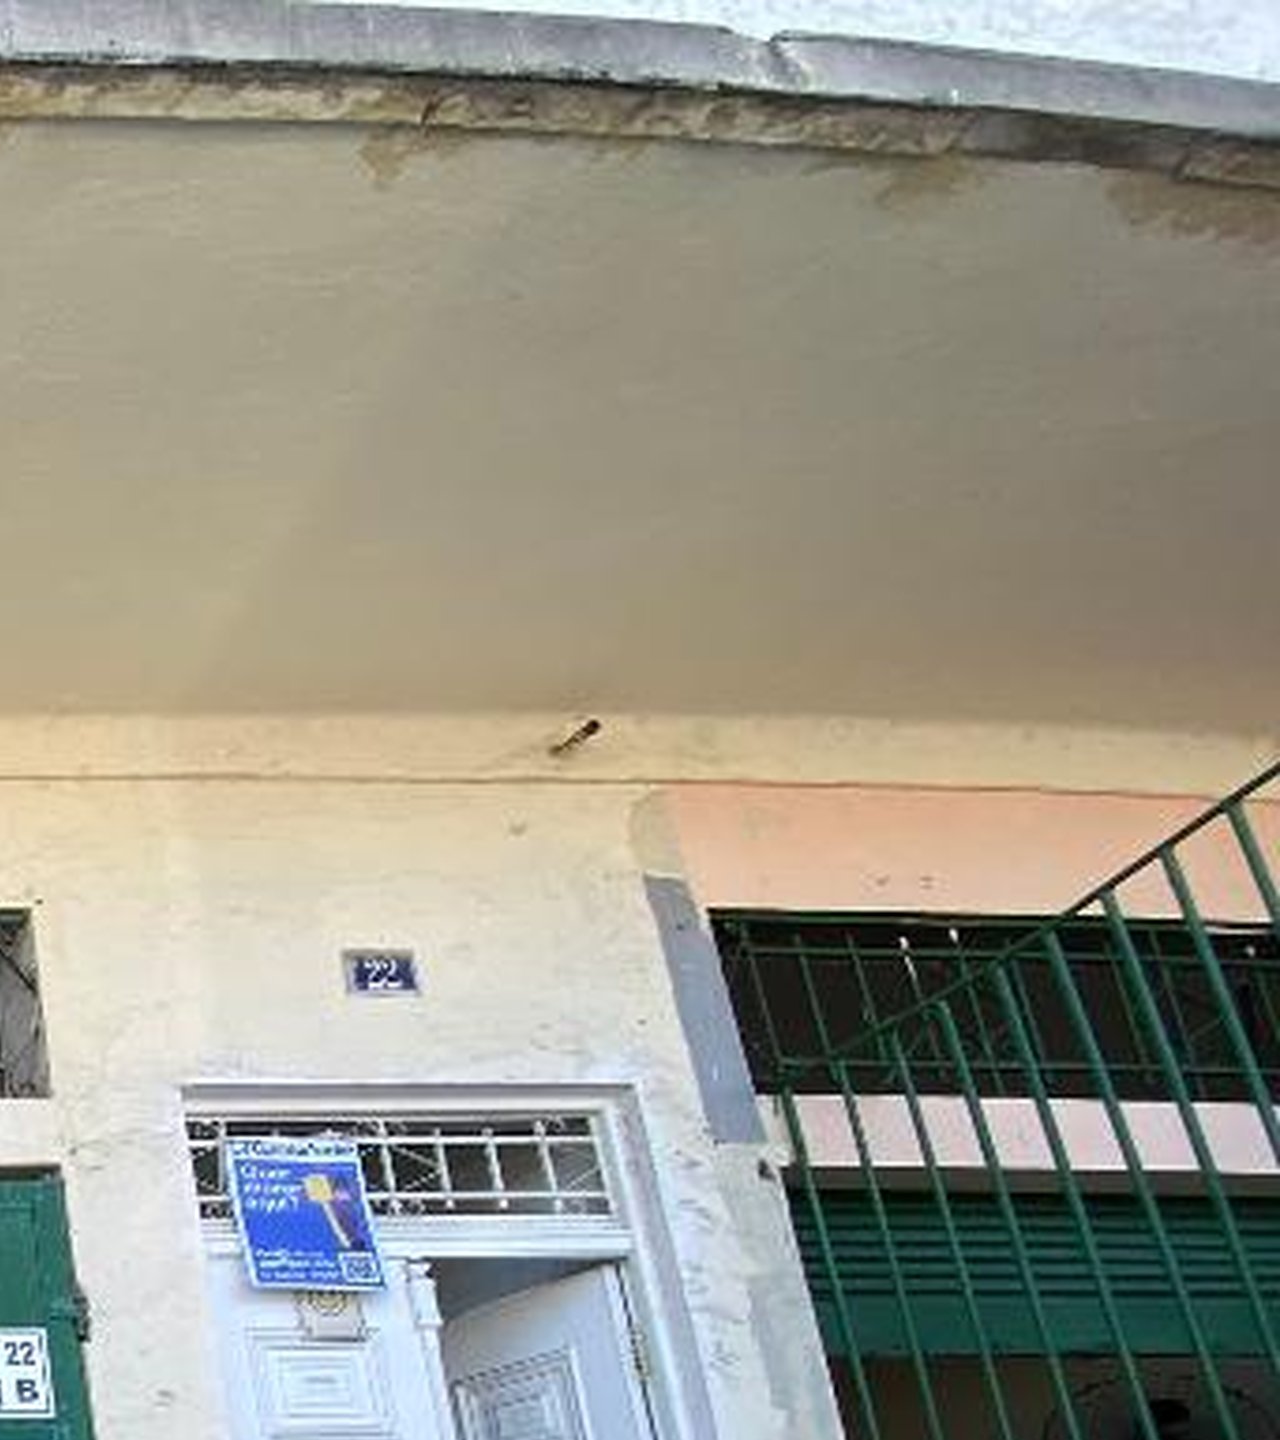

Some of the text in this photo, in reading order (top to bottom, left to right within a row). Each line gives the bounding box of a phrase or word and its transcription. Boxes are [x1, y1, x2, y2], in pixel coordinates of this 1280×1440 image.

[364, 957, 402, 987] 22
[4, 1341, 37, 1366] 22
[16, 1379, 40, 1403] B
